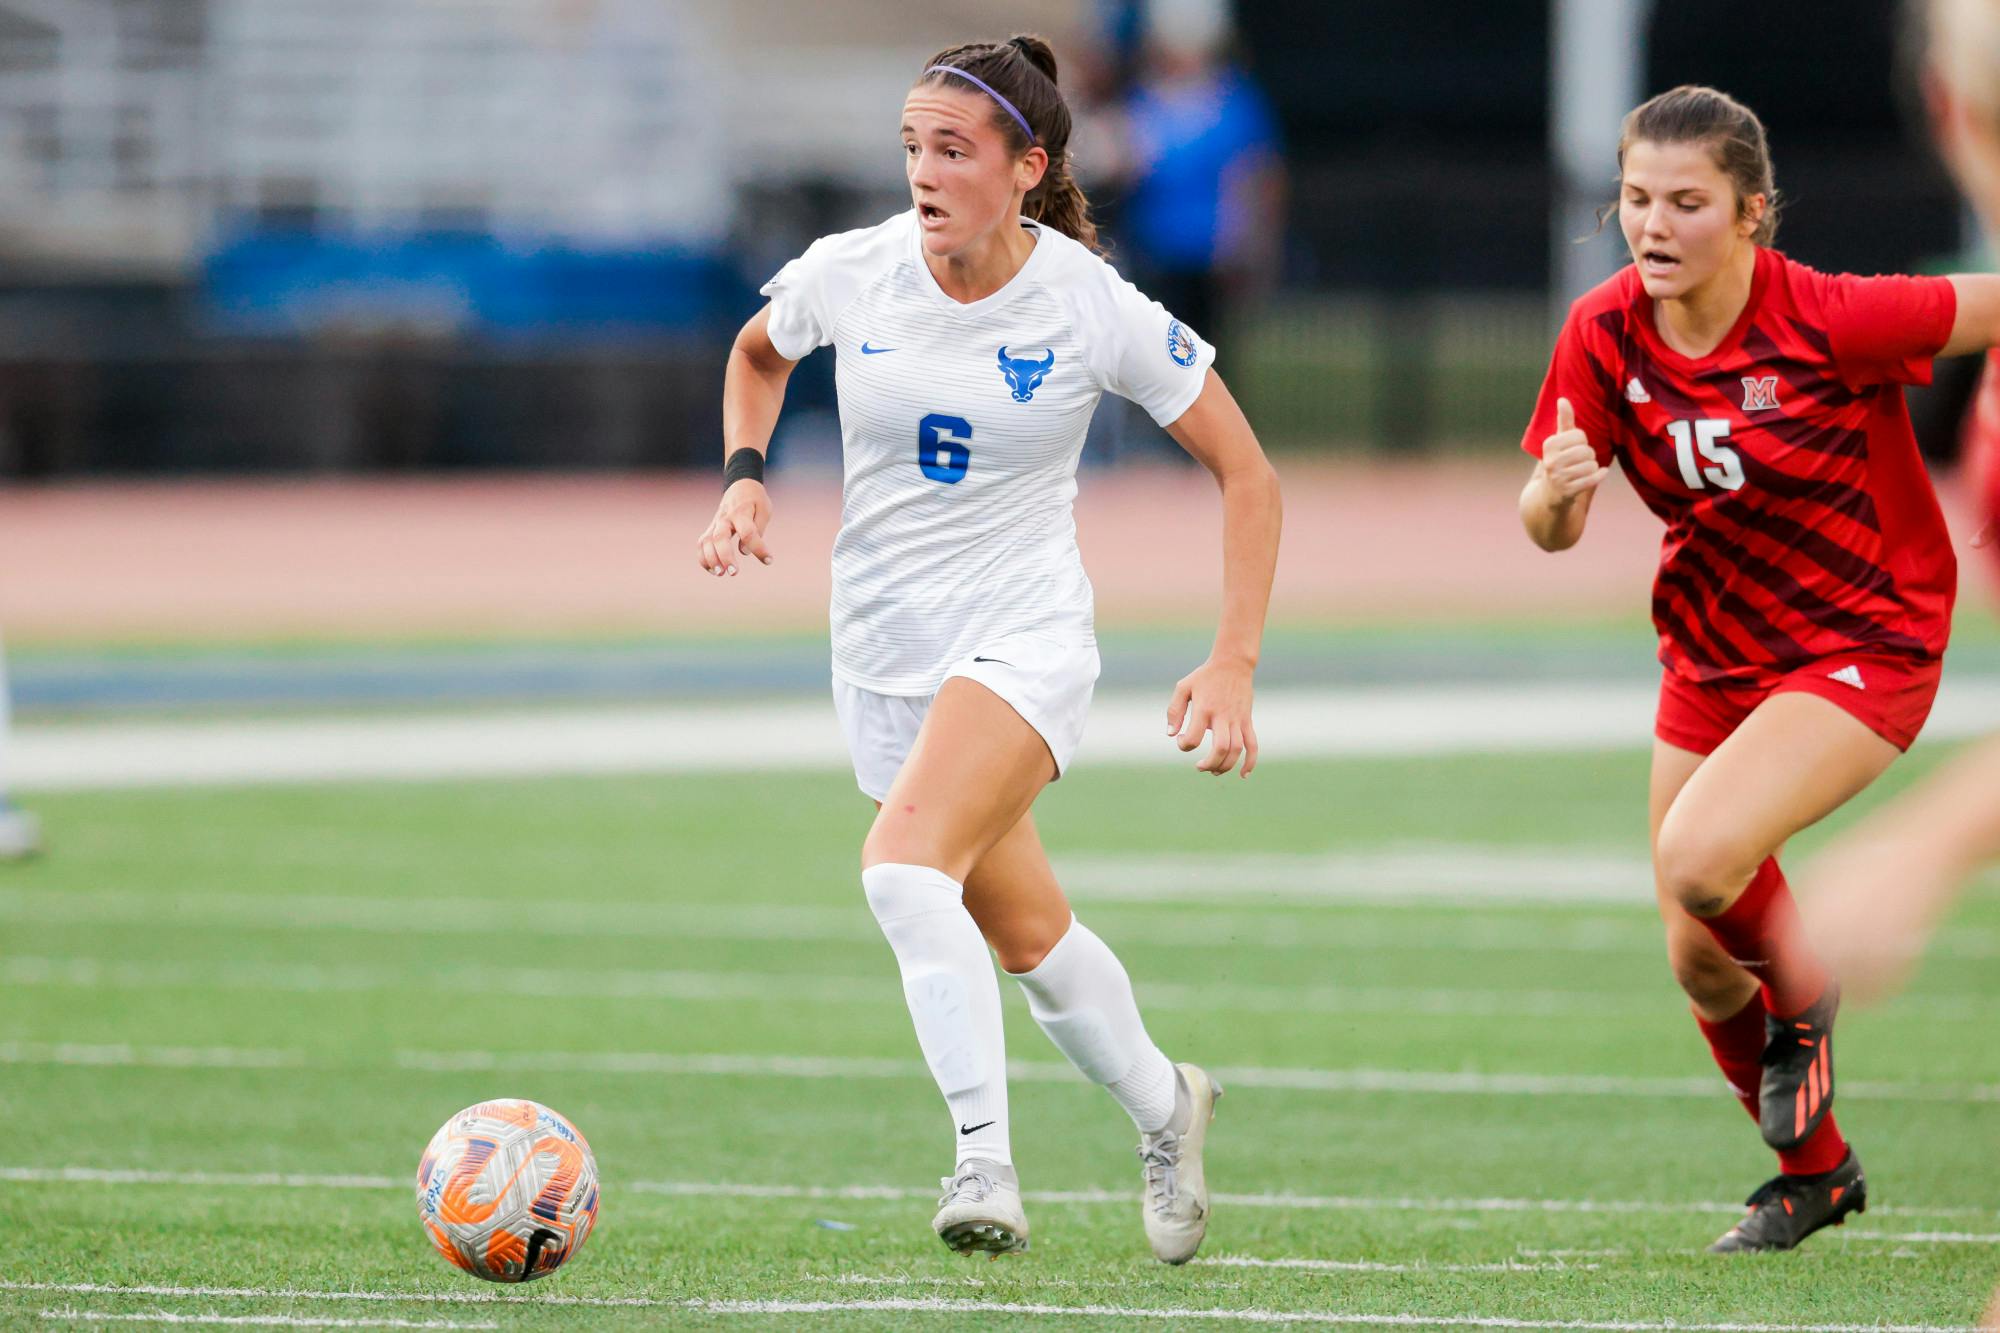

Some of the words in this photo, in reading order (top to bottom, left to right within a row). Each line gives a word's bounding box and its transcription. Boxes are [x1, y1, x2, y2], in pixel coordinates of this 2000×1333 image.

[1741, 376, 1781, 410] M
[918, 412, 973, 484] 6
[1666, 419, 1746, 491] 15
